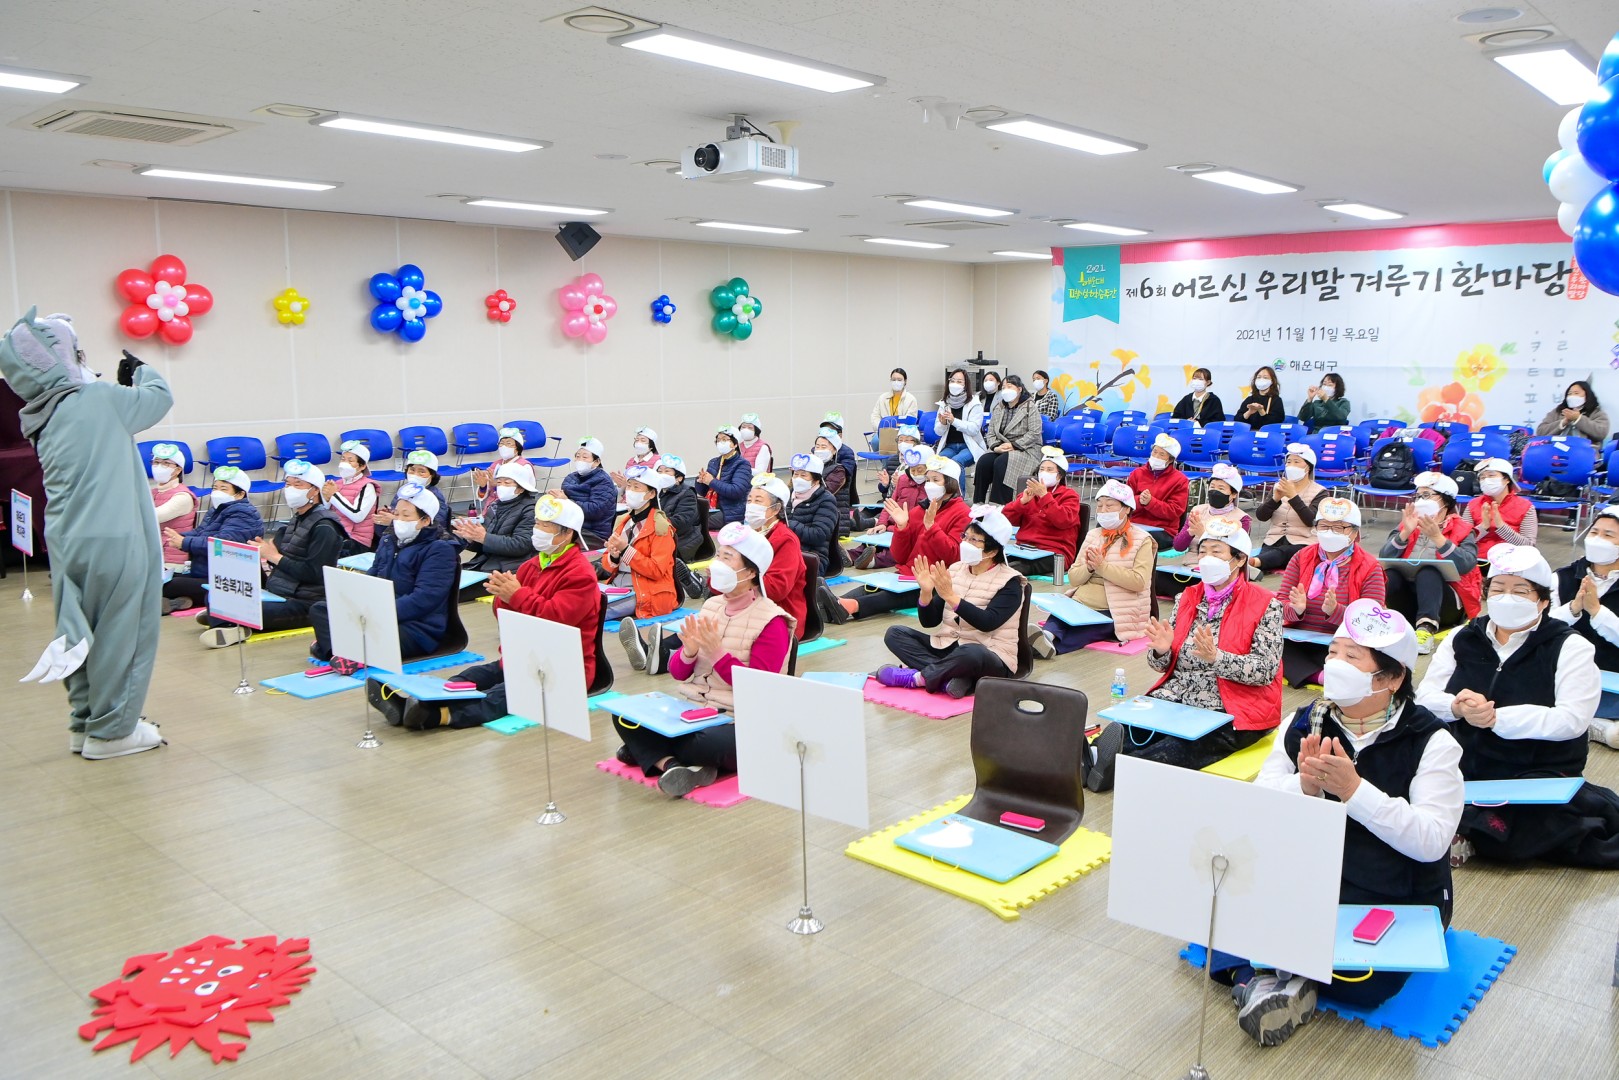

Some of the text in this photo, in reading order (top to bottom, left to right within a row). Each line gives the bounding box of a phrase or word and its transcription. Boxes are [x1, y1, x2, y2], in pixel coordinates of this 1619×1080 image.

[1126, 277, 1166, 299] 제6회
[1171, 272, 1248, 302] 어르신
[1255, 267, 1345, 302] 우리말
[1350, 264, 1442, 297] 겨루기
[1451, 260, 1573, 297] 한마당
[1236, 326, 1380, 342] 2021년 11월 11일 목요일
[1289, 360, 1338, 372] 해운대구
[214, 574, 253, 598] 반송복지관
